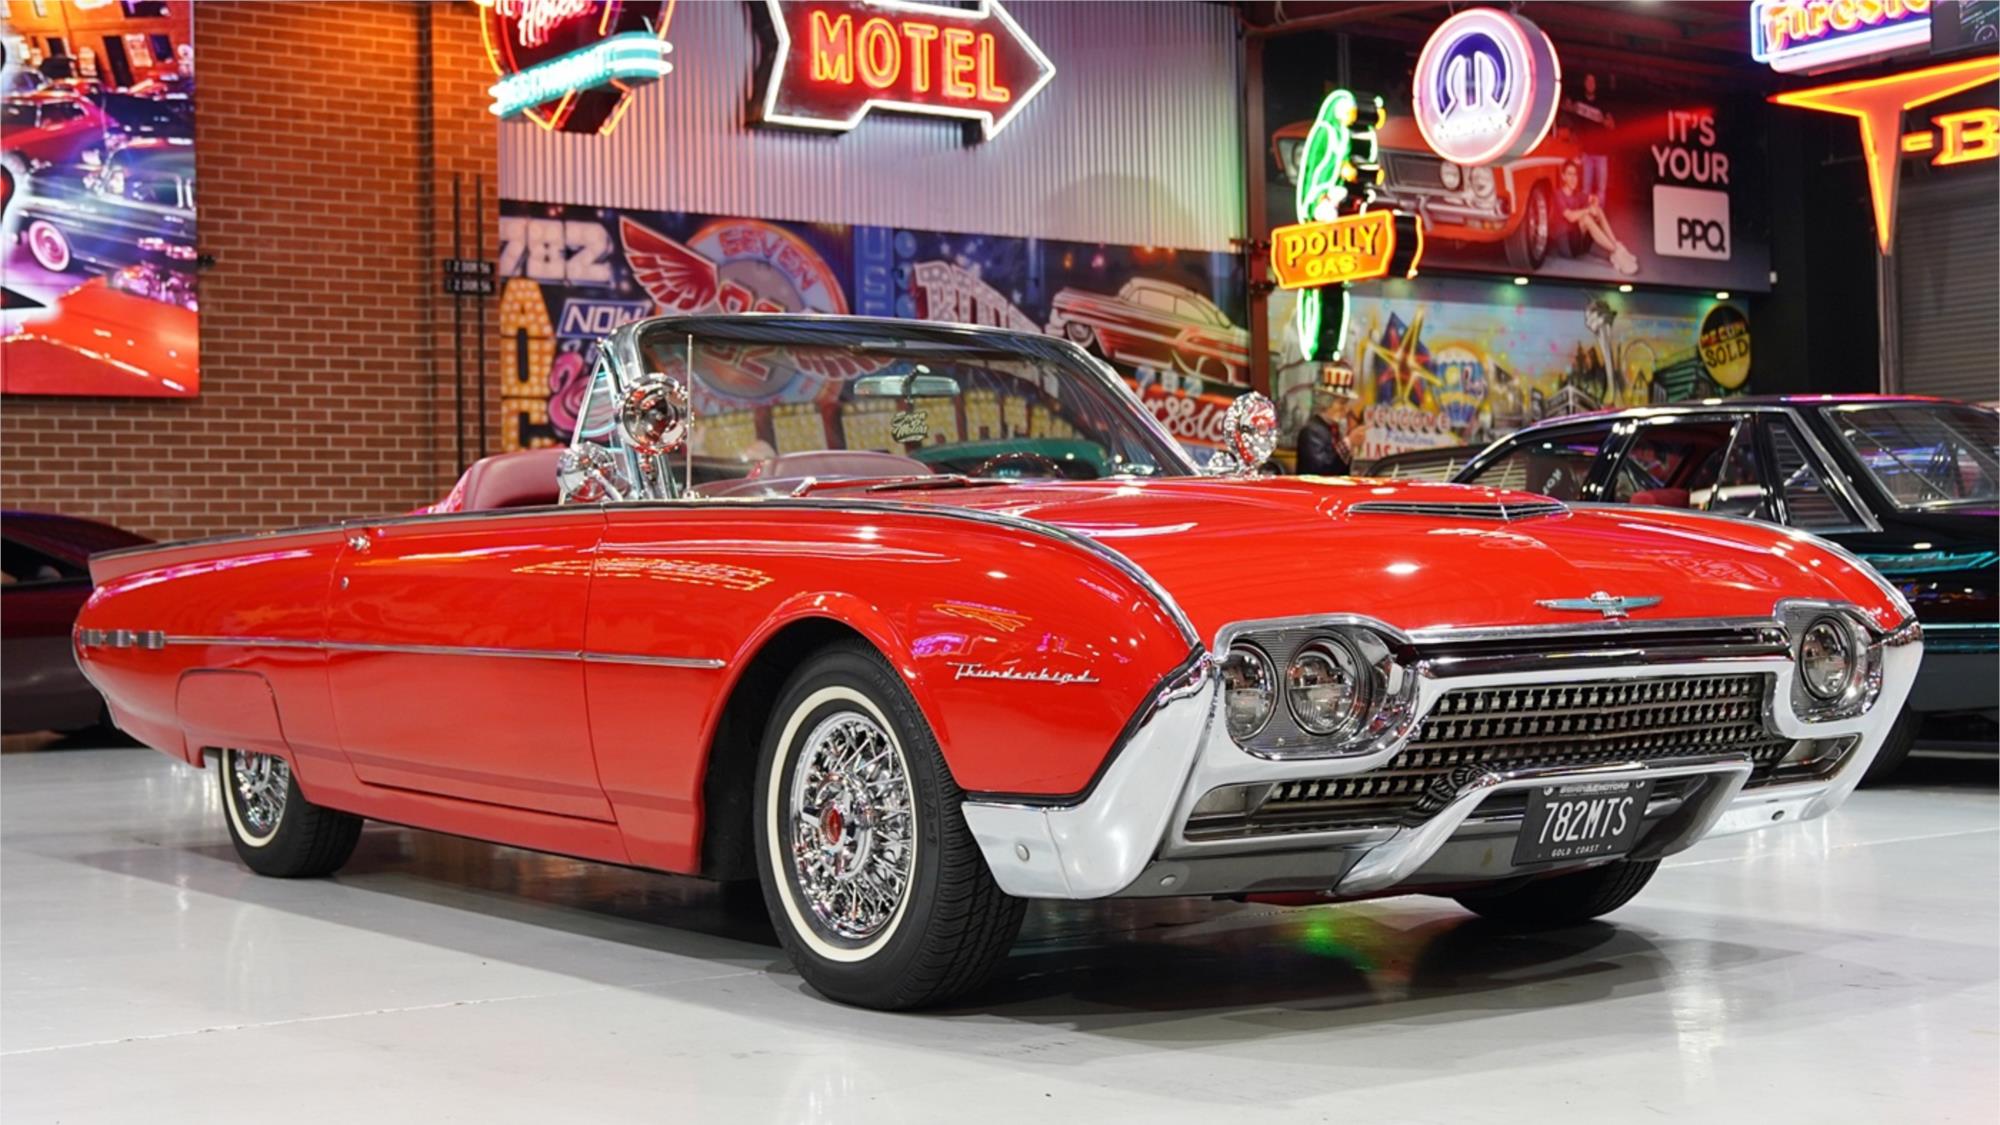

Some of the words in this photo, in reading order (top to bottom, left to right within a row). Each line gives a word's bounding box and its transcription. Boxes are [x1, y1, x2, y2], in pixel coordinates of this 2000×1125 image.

[810, 10, 1011, 102] MOTEL
[1668, 110, 1716, 146] IT'S
[1651, 144, 1729, 184] YOUR
[498, 216, 614, 286] 782
[1284, 222, 1381, 268] POLLY
[1677, 217, 1726, 253] PPQ
[718, 229, 818, 291] SEVEN
[1305, 254, 1357, 277] GAS
[564, 304, 643, 333] NOW
[1705, 338, 1749, 368] SOLD
[946, 661, 1100, 686] Thunderbird
[1538, 796, 1633, 844] 782MTS
[1551, 847, 1571, 857] GOLD
[1575, 844, 1600, 855] COAST
